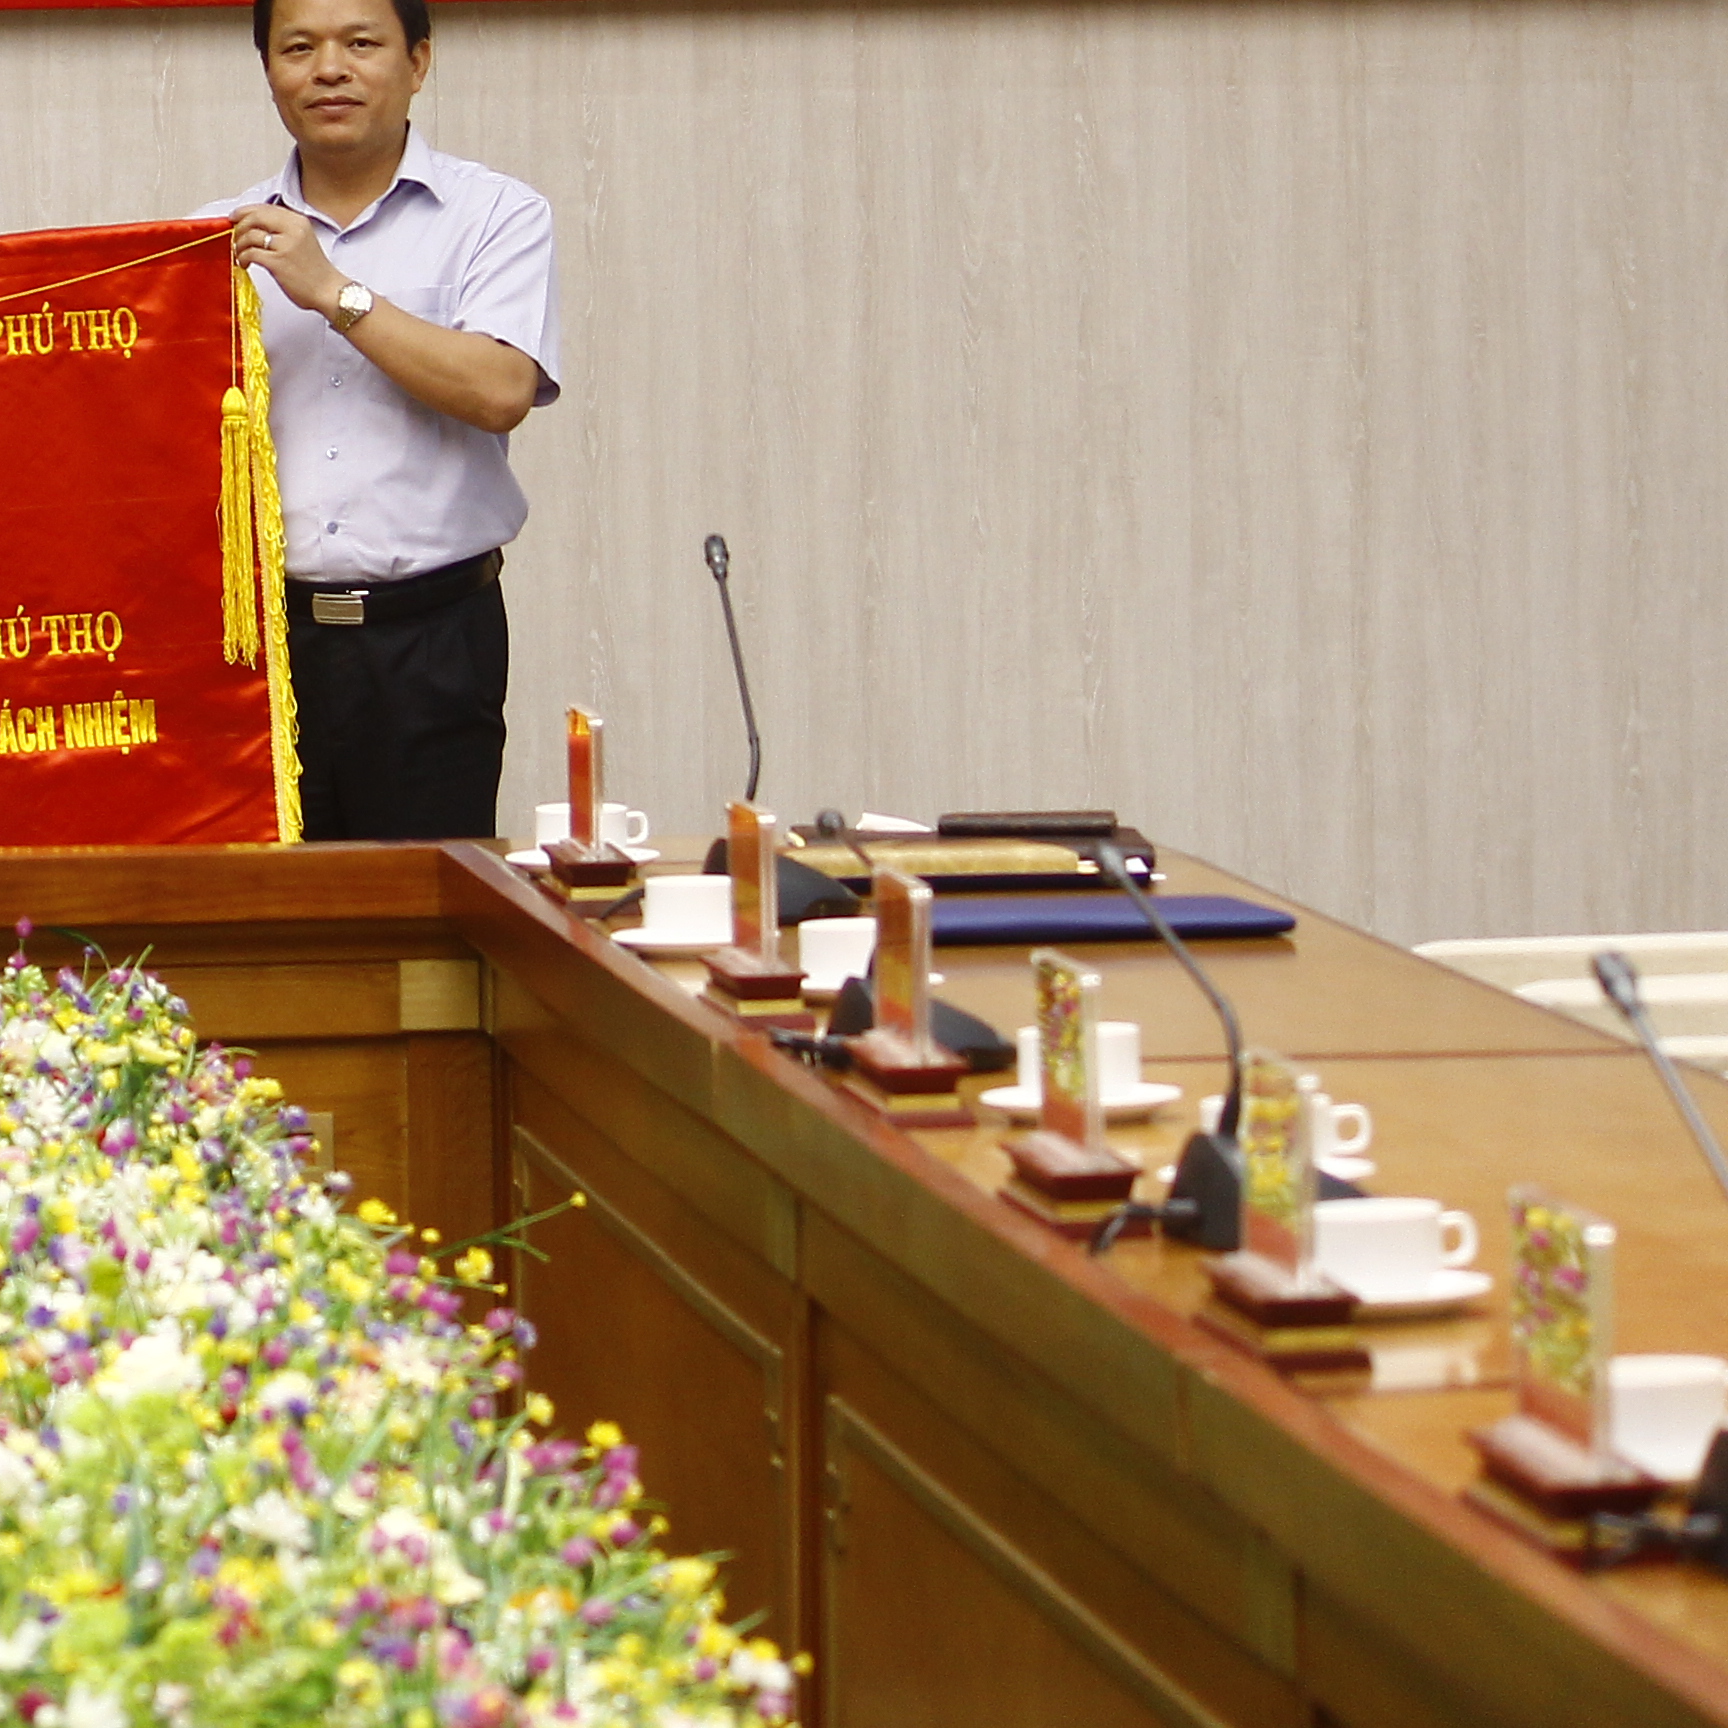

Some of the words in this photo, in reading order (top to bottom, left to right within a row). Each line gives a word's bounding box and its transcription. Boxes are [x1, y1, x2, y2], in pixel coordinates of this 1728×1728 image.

[63, 307, 139, 359] THỌ
[41, 611, 124, 663] THỌ
[63, 690, 157, 756] NHIỆM
